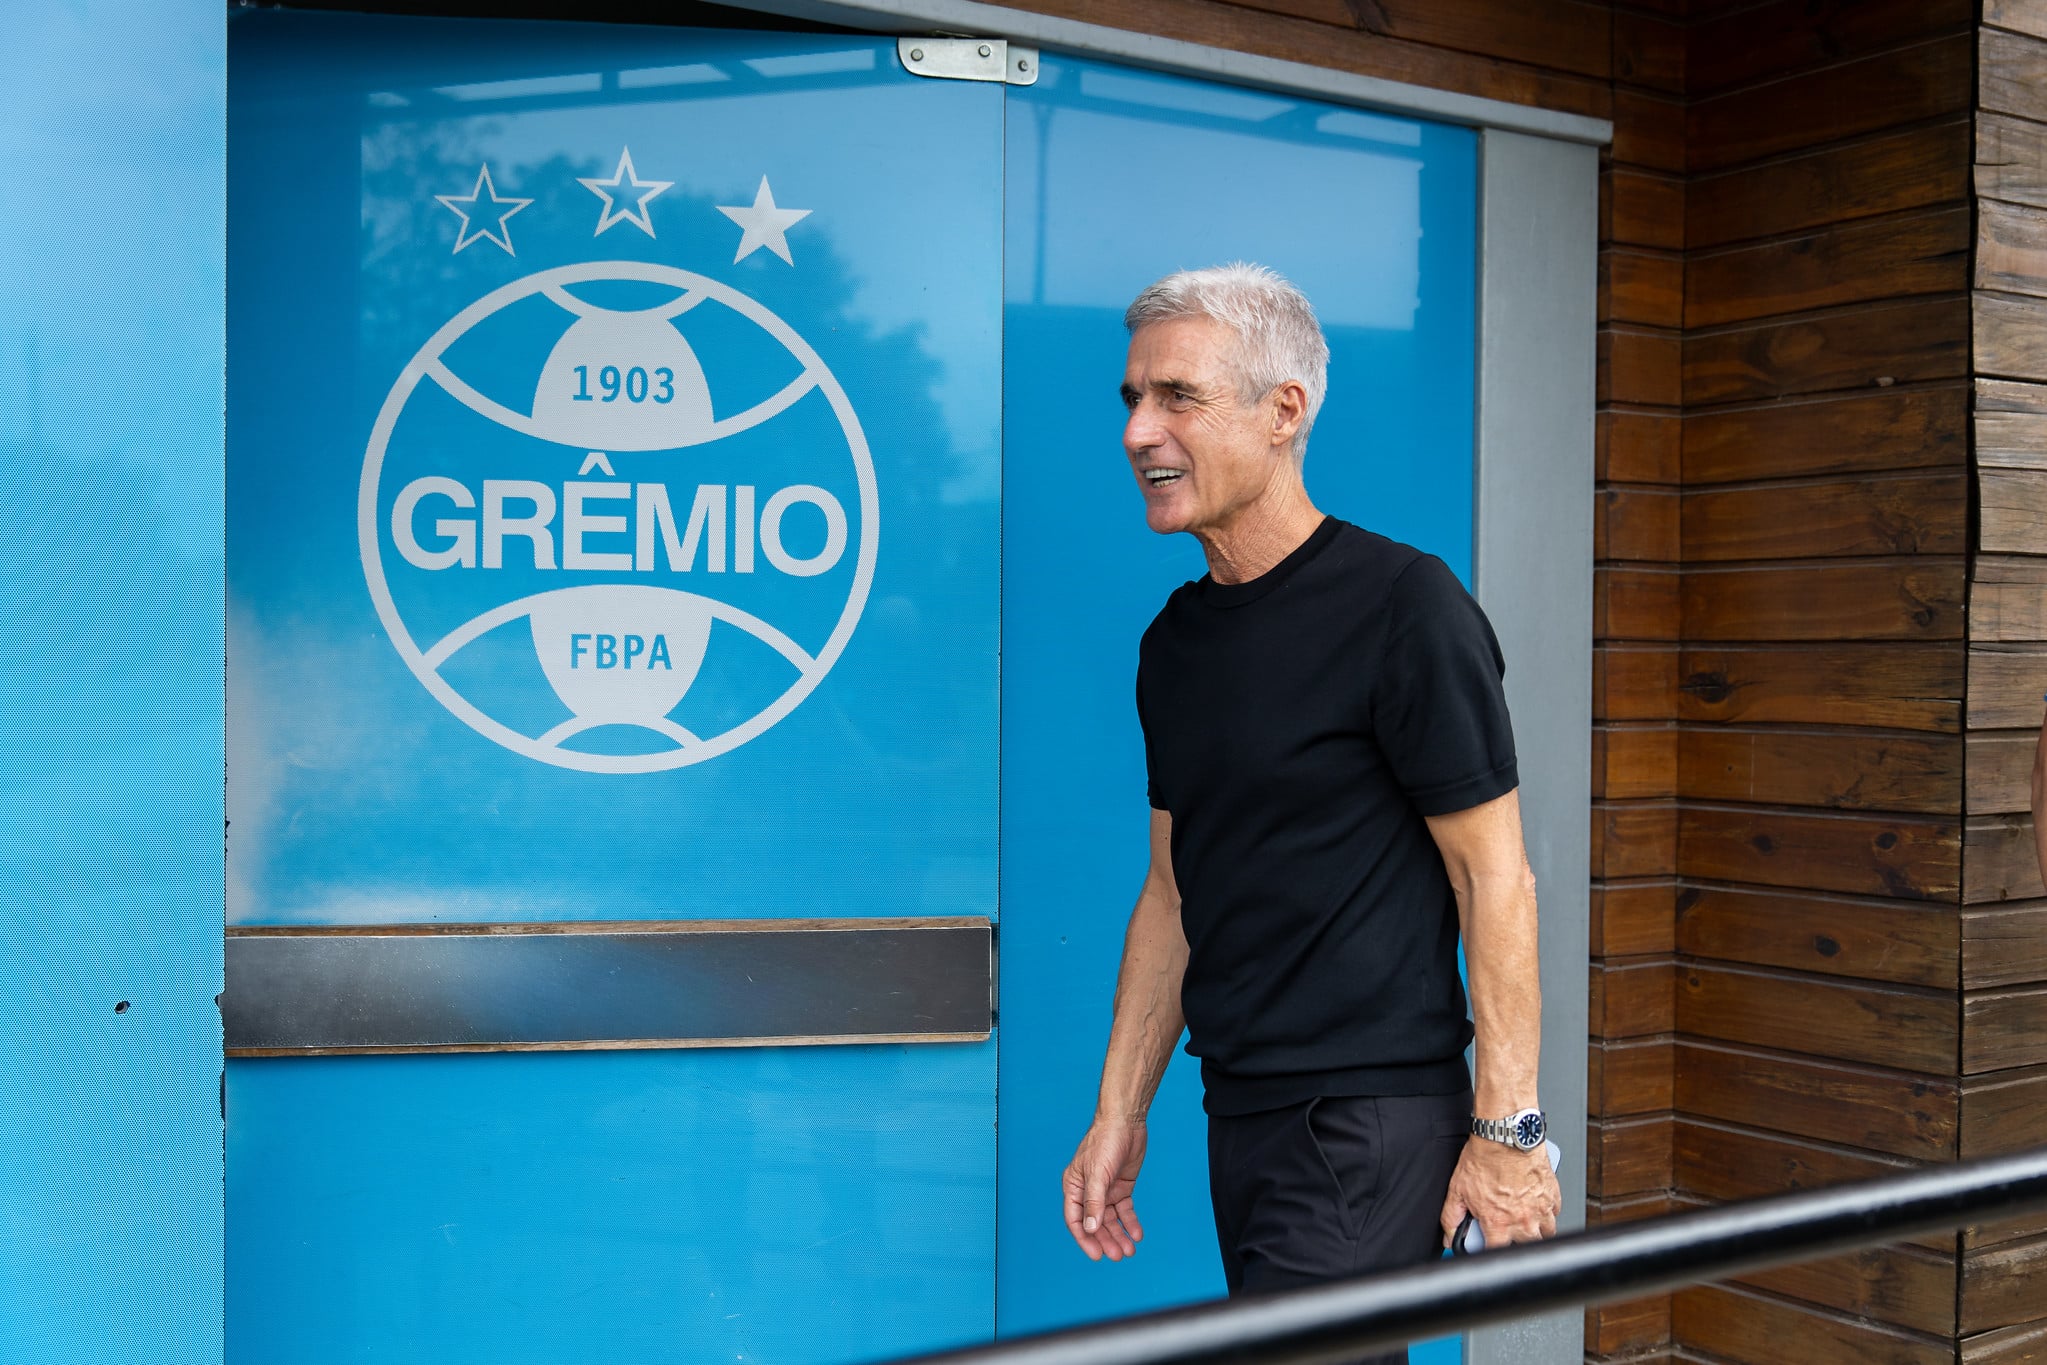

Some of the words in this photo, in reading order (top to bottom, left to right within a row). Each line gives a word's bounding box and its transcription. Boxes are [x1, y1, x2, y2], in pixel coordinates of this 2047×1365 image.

[573, 365, 674, 404] 1903
[391, 452, 849, 576] GRÊMIO
[571, 634, 672, 670] FBPA
